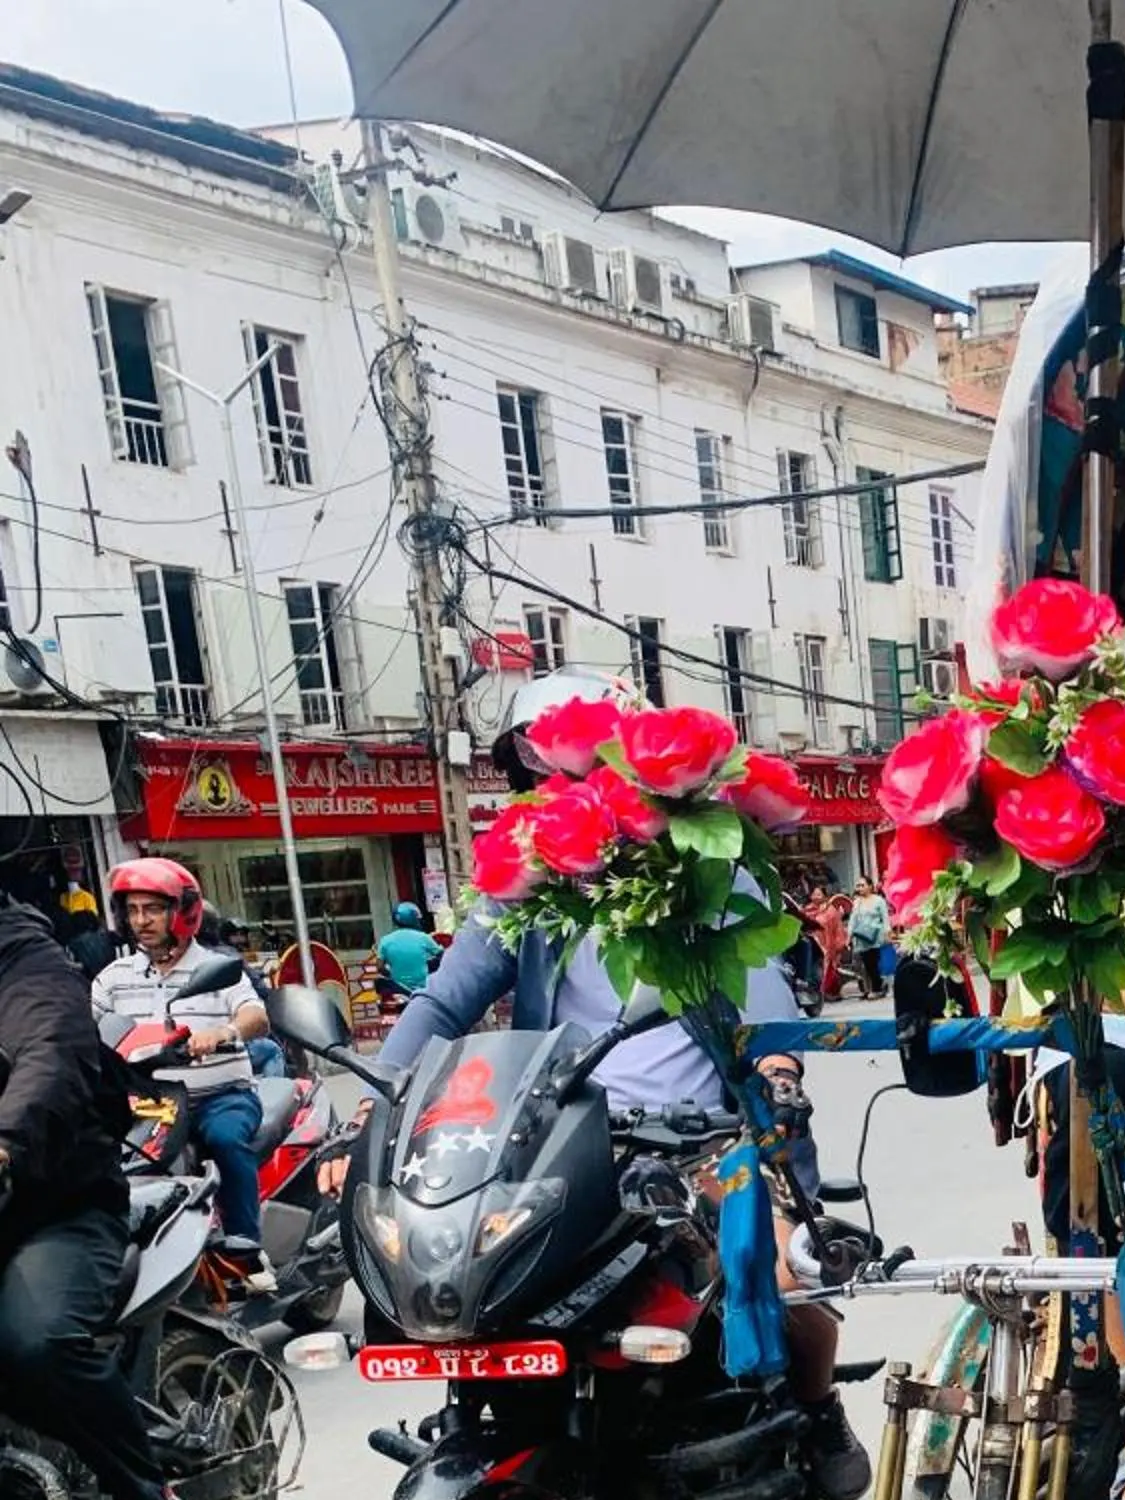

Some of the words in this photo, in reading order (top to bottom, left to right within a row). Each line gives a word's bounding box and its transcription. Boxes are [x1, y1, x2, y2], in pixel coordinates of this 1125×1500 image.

[284, 756, 435, 795] RAJSHREE
[799, 772, 870, 800] PALACE
[290, 796, 378, 816] EWELLERS
